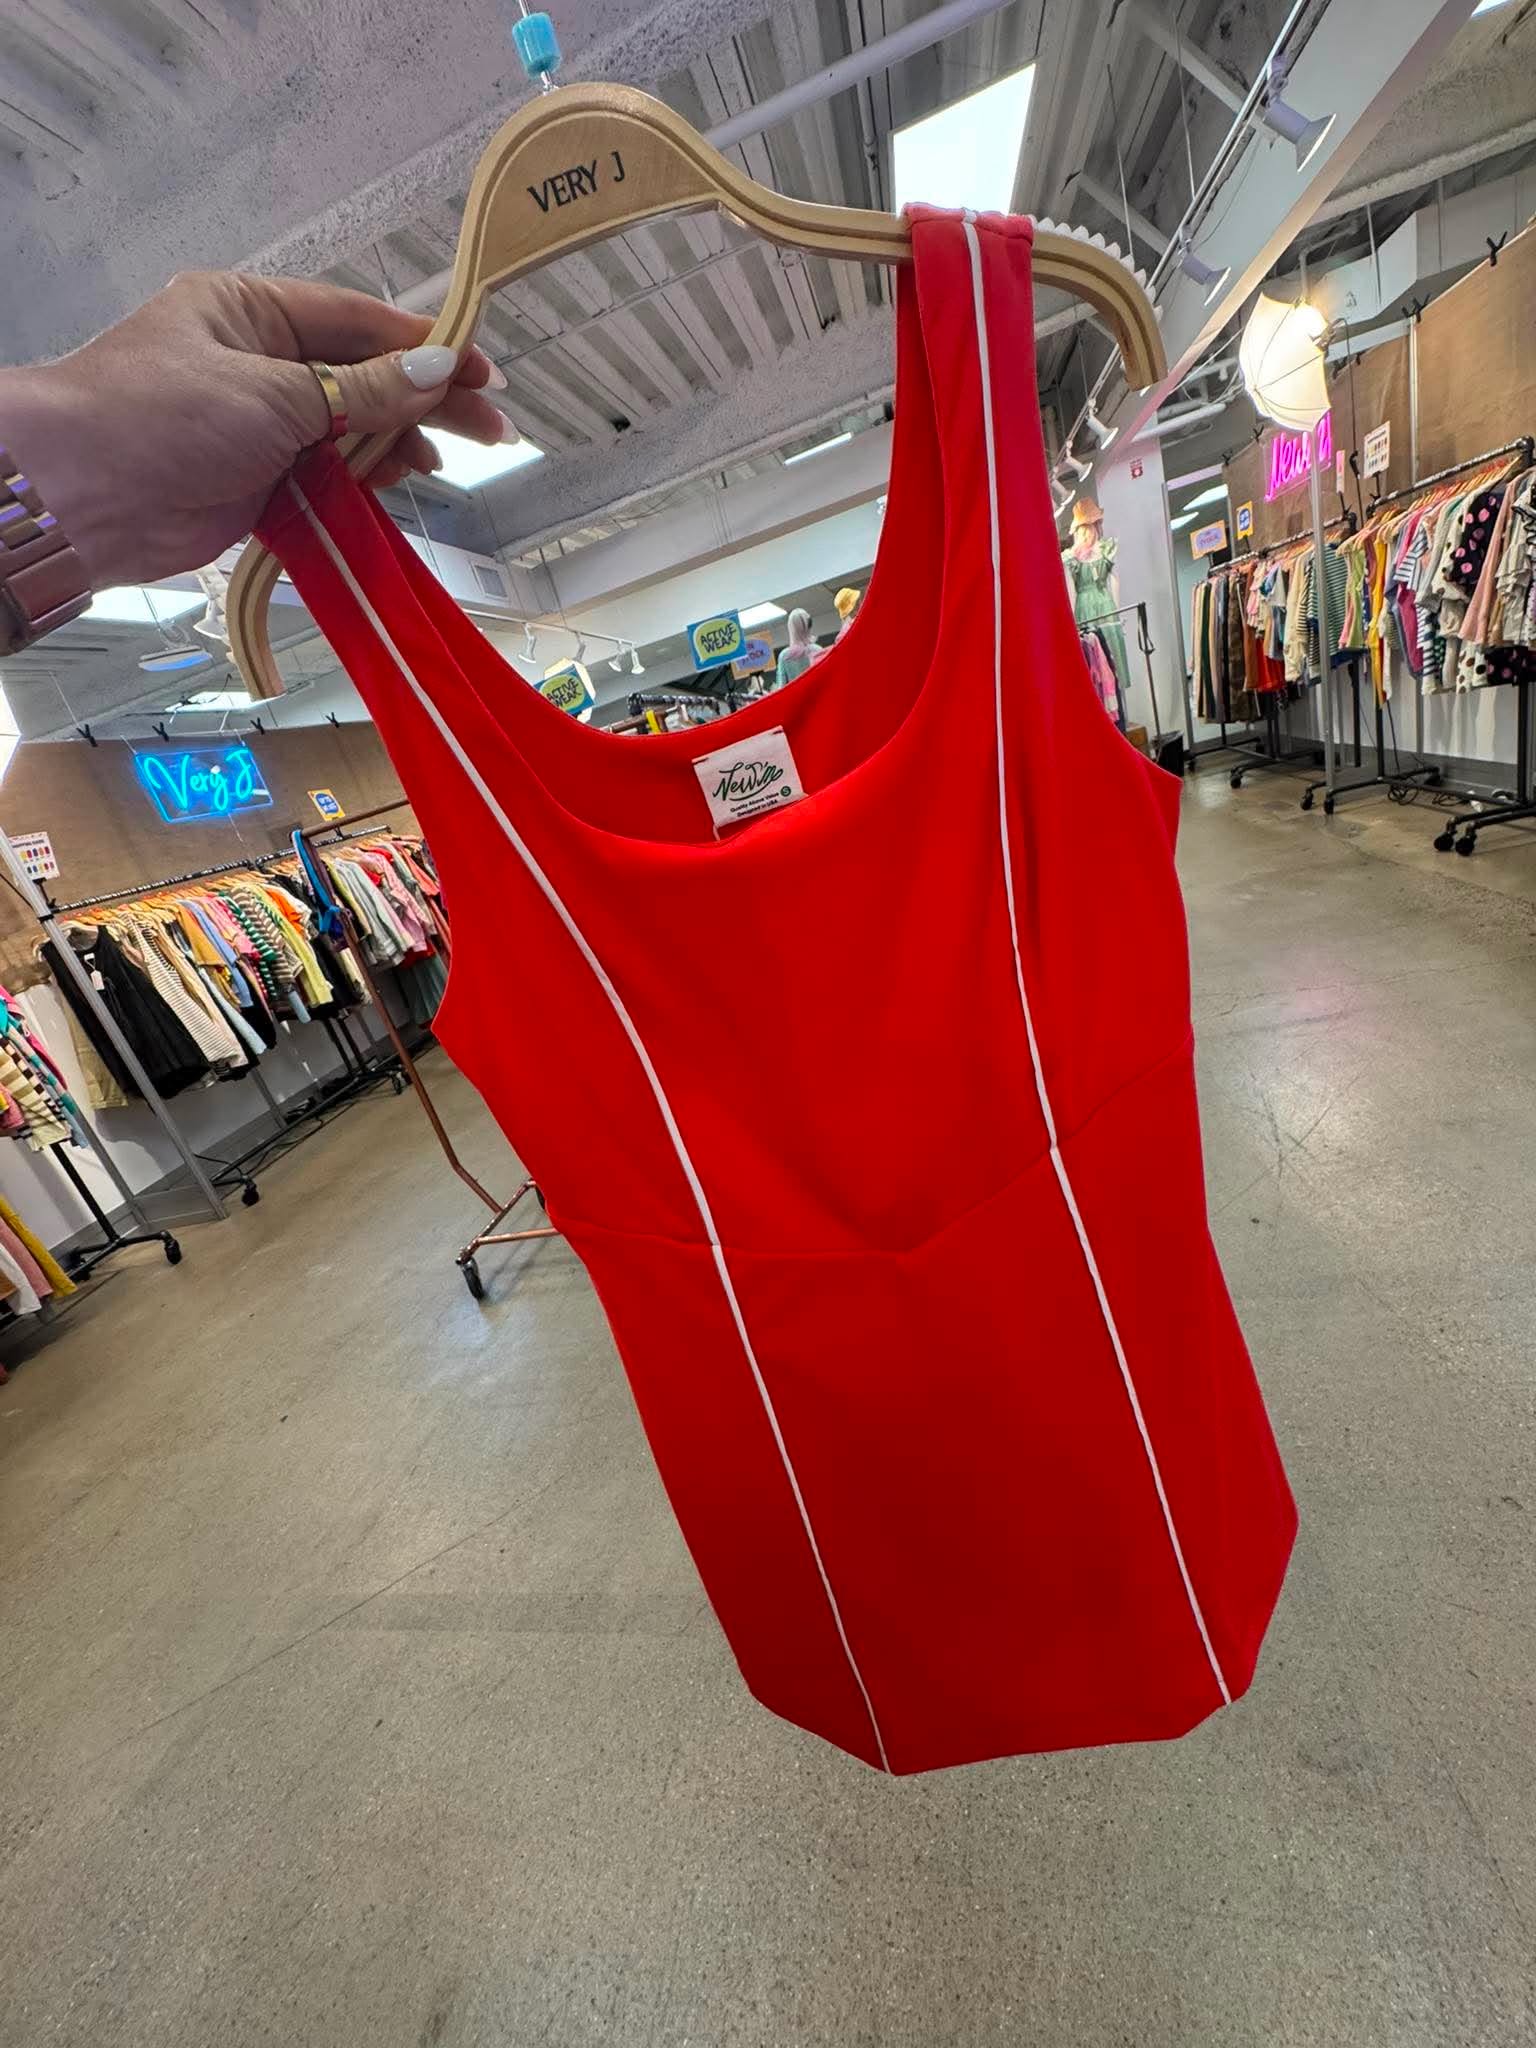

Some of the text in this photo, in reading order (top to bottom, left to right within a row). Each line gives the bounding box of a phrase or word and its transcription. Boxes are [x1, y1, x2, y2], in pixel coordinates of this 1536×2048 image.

[527, 151, 625, 213] VERY J
[700, 622, 737, 645] ACTIVE
[546, 678, 579, 701] ACTIVE
[143, 748, 254, 811] Very J
